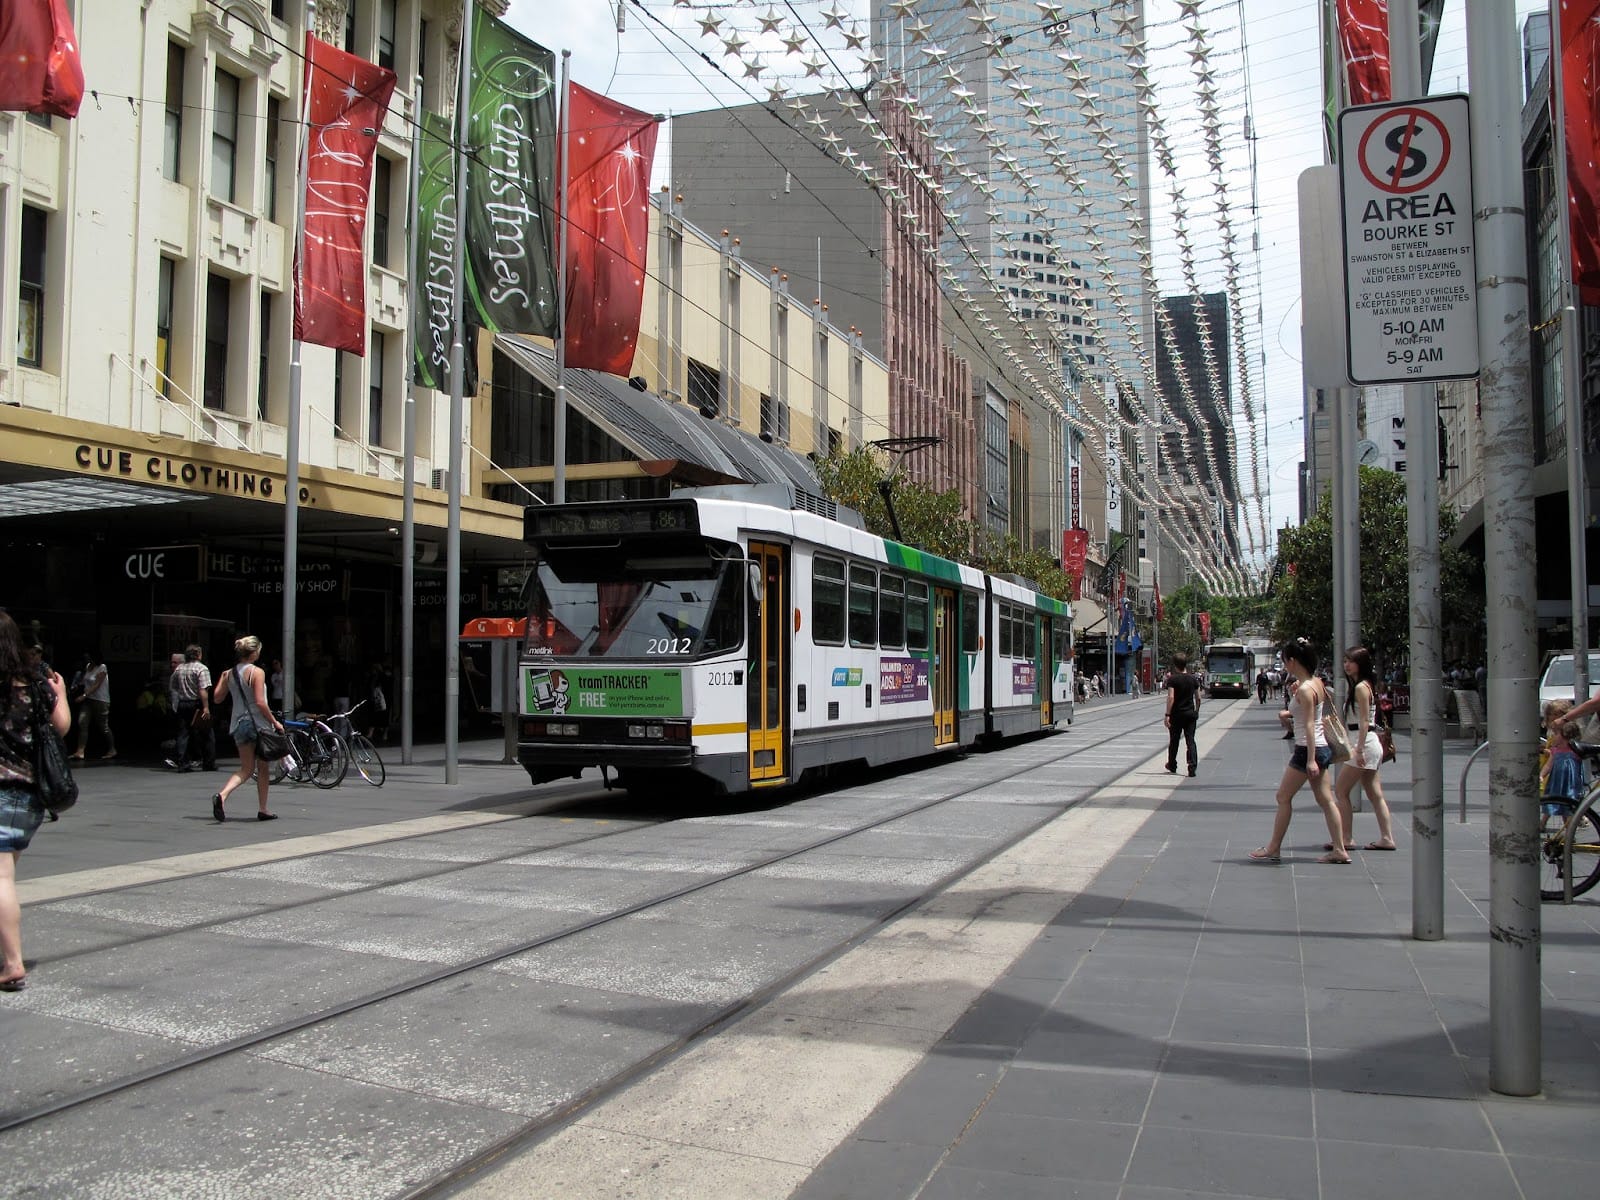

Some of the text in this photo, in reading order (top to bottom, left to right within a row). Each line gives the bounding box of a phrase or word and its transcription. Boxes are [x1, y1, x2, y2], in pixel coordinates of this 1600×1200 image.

[1361, 192, 1456, 223] AREA
[1363, 221, 1455, 242] BOURKE ST
[1391, 241, 1428, 251] BETWEEN
[1351, 246, 1470, 263] SWANSTON ST & ELIZABETH ST
[1362, 269, 1462, 284] VALID PERMIT EXCEPTED
[1366, 262, 1456, 276] VEHICLES DISPLAYING
[1374, 289, 1422, 300] CLASSIFIED
[1425, 286, 1465, 296] VEHICLES
[1355, 299, 1397, 309] EXCEPTED
[1400, 298, 1417, 306] FOR
[1433, 294, 1470, 303] MINUTES
[1372, 303, 1453, 316] MAXIMUM BETWEEN
[1383, 318, 1445, 336] 5-10 AM
[1394, 336, 1433, 346] MON-FRI
[1386, 347, 1443, 365] 5-9 AM
[1406, 366, 1423, 374] SAT
[75, 445, 317, 503] CUE CLOTHING O.
[1071, 468, 1079, 525] CAUSEWAY
[658, 510, 677, 528] 86
[125, 552, 166, 579] CUE
[251, 580, 337, 593] THE BY SHOP
[528, 646, 553, 655] metlink
[646, 637, 692, 655] 2012
[708, 671, 734, 686] 2012
[579, 692, 607, 708] FREE
